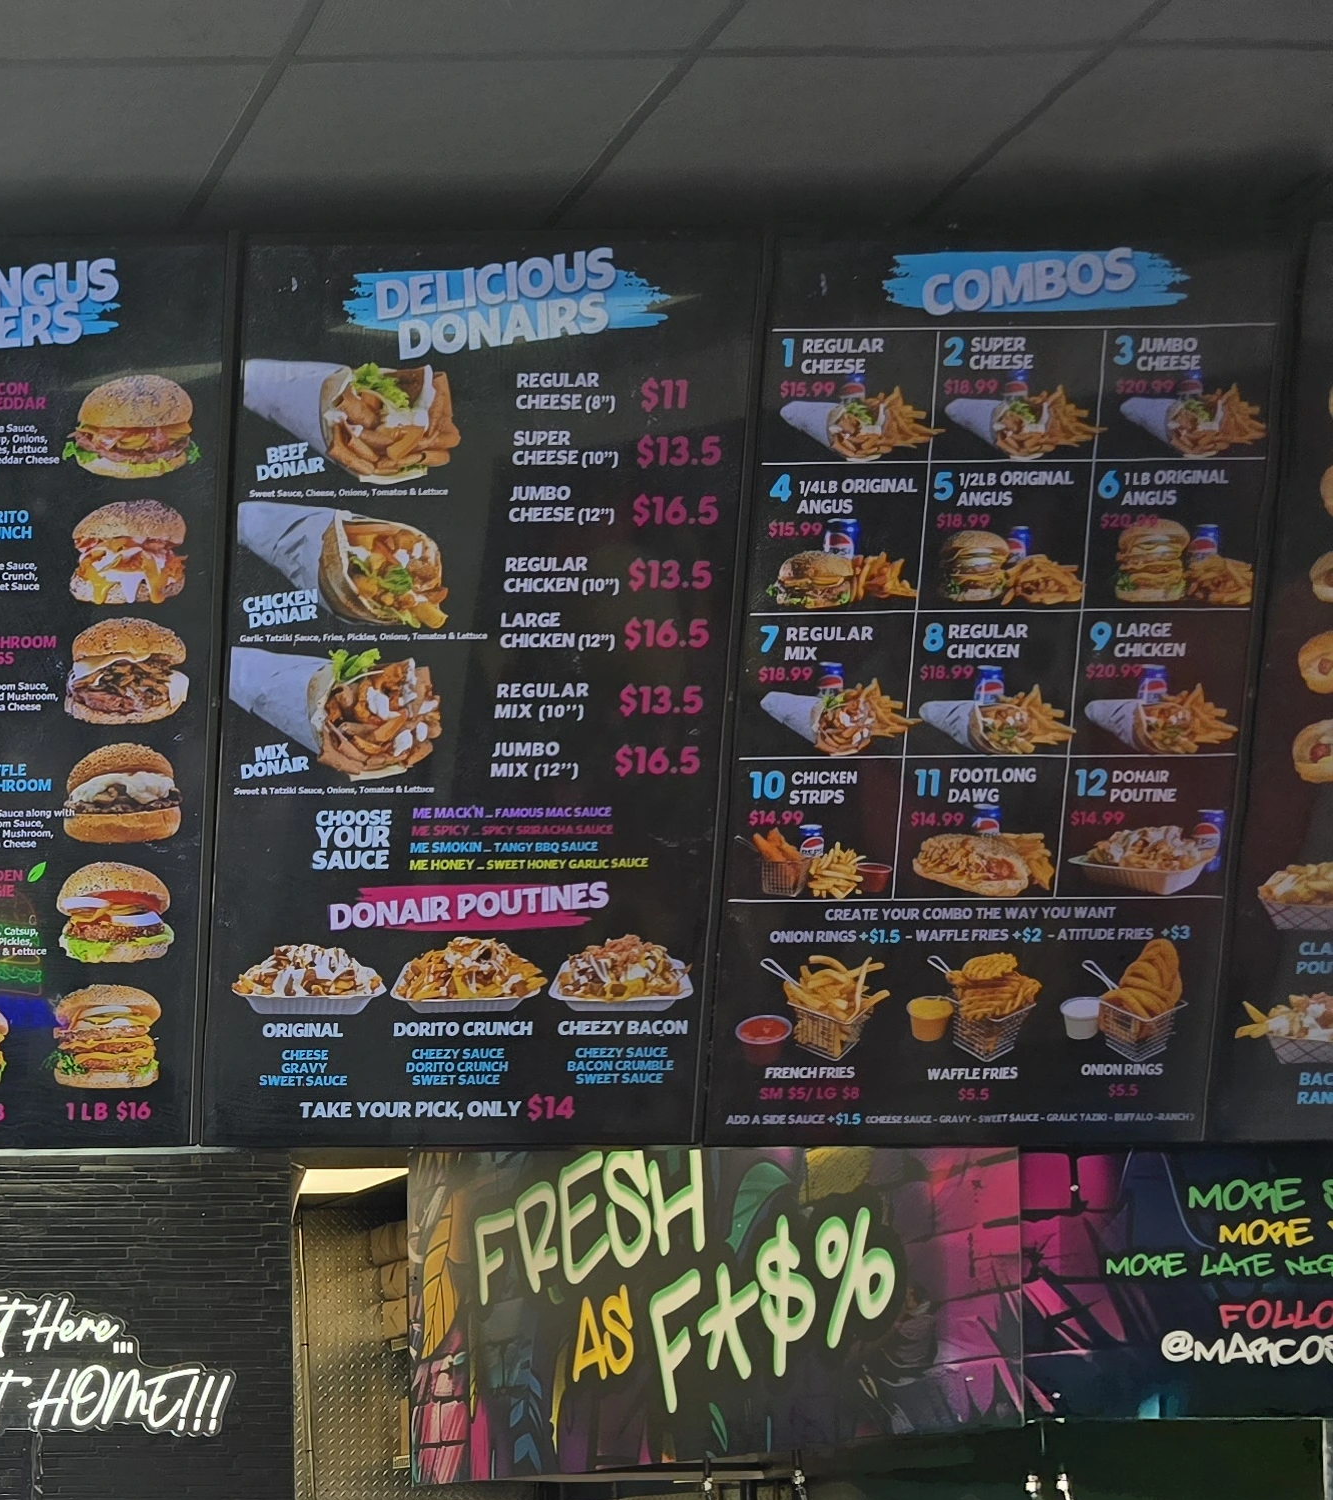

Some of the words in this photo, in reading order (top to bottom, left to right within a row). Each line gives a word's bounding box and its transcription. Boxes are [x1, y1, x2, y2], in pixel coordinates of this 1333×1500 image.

[375, 247, 616, 321] DELICIOUS
[922, 247, 1136, 315] COMBOS
[399, 291, 609, 360] DONAIRS
[782, 338, 795, 367] 1
[802, 338, 883, 353] REGULAR
[801, 359, 865, 374] CHEESE
[516, 394, 582, 411] CHEESE
[517, 373, 599, 389] REGULAR
[641, 379, 687, 412] $11
[780, 381, 835, 397] $15.99
[750, 770, 785, 799] 10
[791, 771, 857, 785] CHICKEN
[789, 790, 845, 804] STRIPS
[749, 811, 803, 826] $14.99
[330, 899, 451, 931] DONAIR
[458, 881, 609, 920] POUTINES
[81, 1102, 108, 1119] LB
[117, 1102, 151, 1121] $16
[300, 1102, 352, 1119] TAKE
[357, 1102, 412, 1118] YOUR
[416, 1101, 464, 1120] PICK,
[467, 1101, 521, 1117] ONLY
[528, 1095, 575, 1121] $14
[1189, 1178, 1305, 1214] MORE
[473, 1147, 705, 1305] FRESH
[1219, 1218, 1314, 1247] MORE
[1106, 1253, 1187, 1278] MORE
[1200, 1253, 1274, 1277] LATE
[573, 1284, 633, 1384] AS
